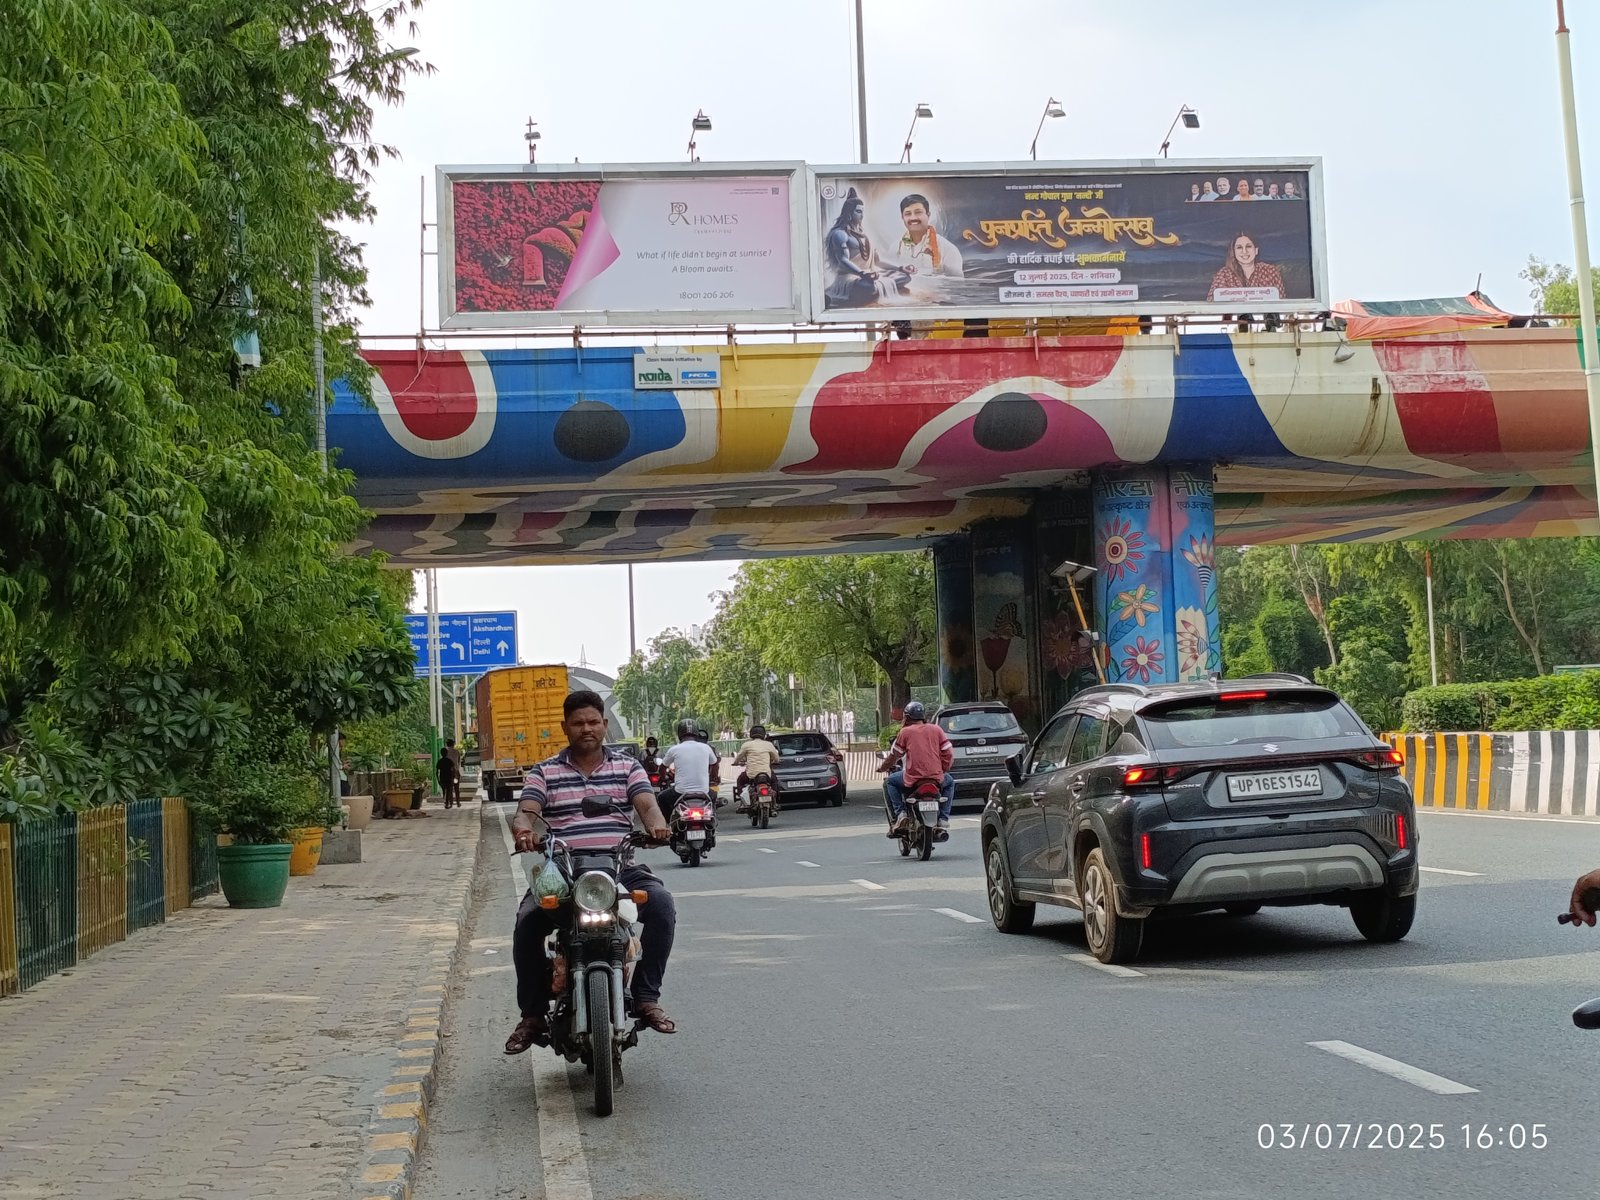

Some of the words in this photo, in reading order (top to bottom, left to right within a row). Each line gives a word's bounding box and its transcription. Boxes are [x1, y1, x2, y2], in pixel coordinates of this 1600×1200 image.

[694, 215, 738, 225] HOMES
[661, 250, 666, 260] if
[668, 250, 680, 260] life
[682, 250, 704, 259] didn't
[706, 250, 727, 259] begin
[1007, 253, 1017, 264] की
[680, 265, 704, 273] Bloom
[1028, 273, 1047, 282] जुलाई
[1071, 272, 1083, 280] दिन
[1090, 271, 1115, 279] शनिवार
[703, 291, 717, 299] 206
[1238, 773, 1319, 793] UP16ES1542
